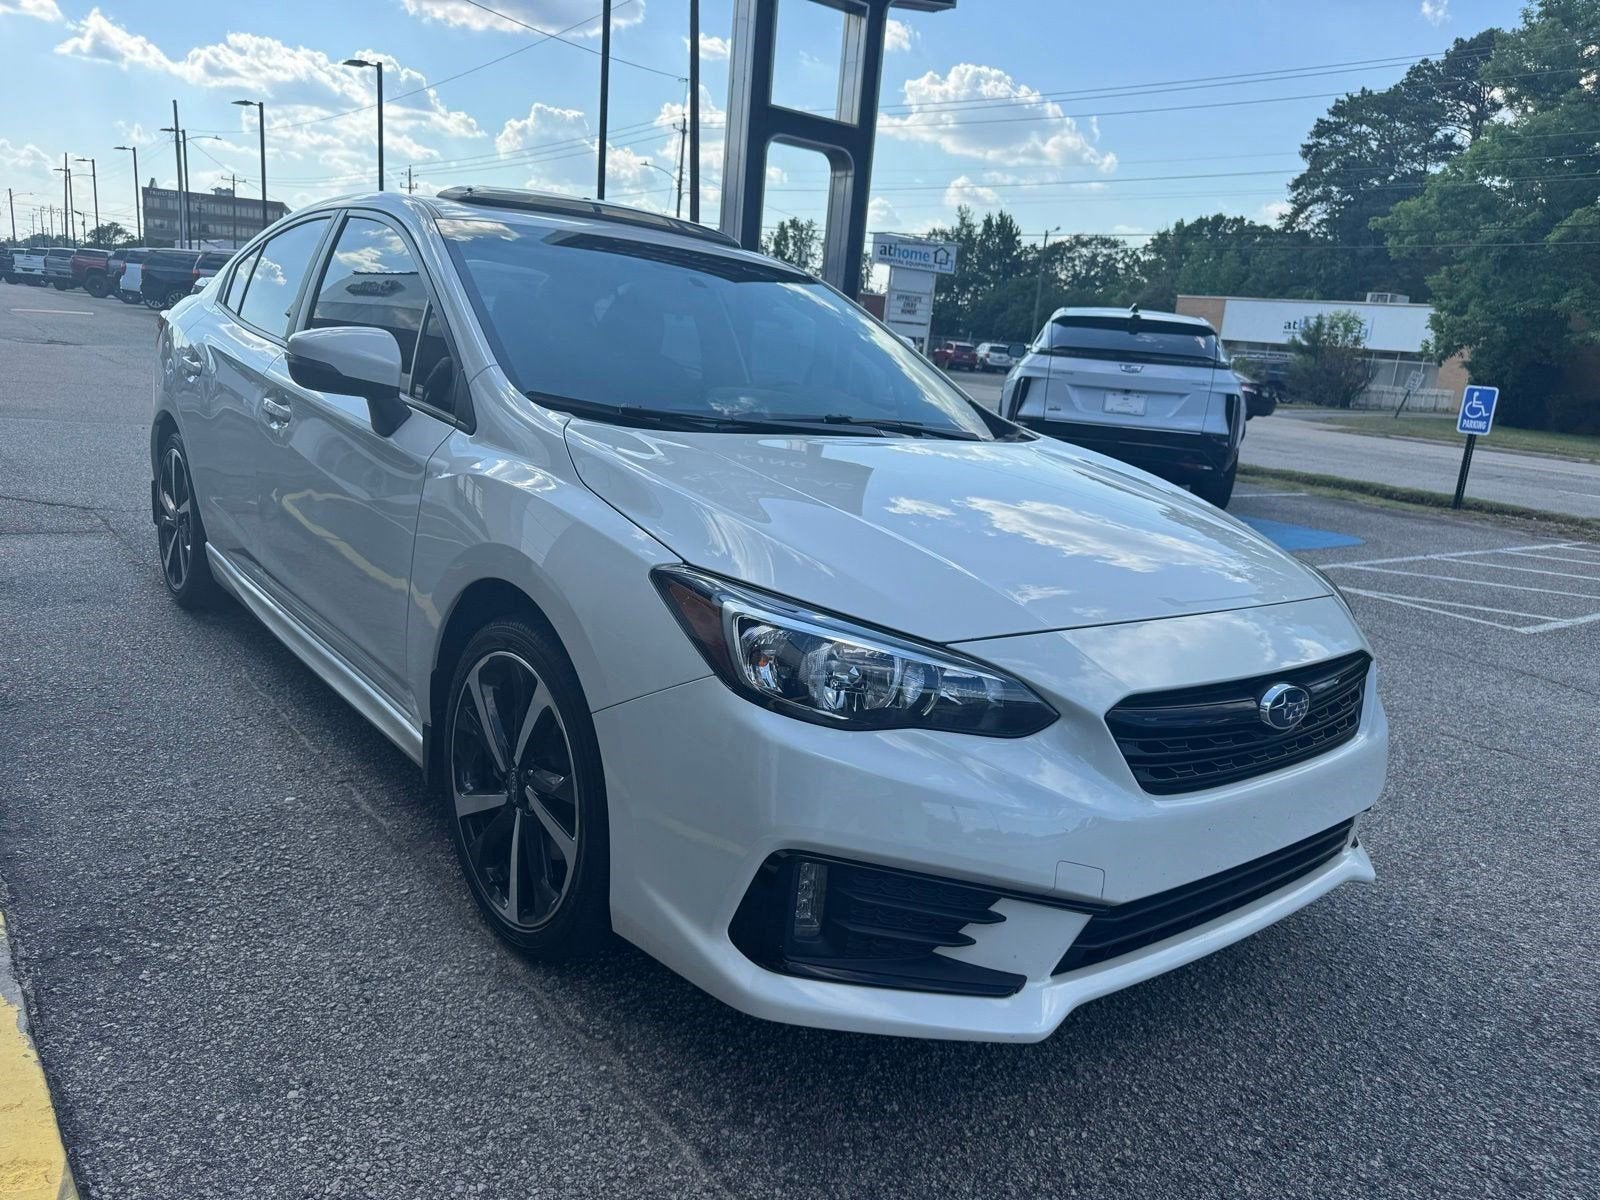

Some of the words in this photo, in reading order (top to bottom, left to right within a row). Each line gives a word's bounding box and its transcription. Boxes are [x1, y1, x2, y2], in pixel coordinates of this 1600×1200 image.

[879, 243, 930, 262] athome
[904, 260, 936, 269] EQUIPMENT
[1462, 419, 1487, 430] PARKING
